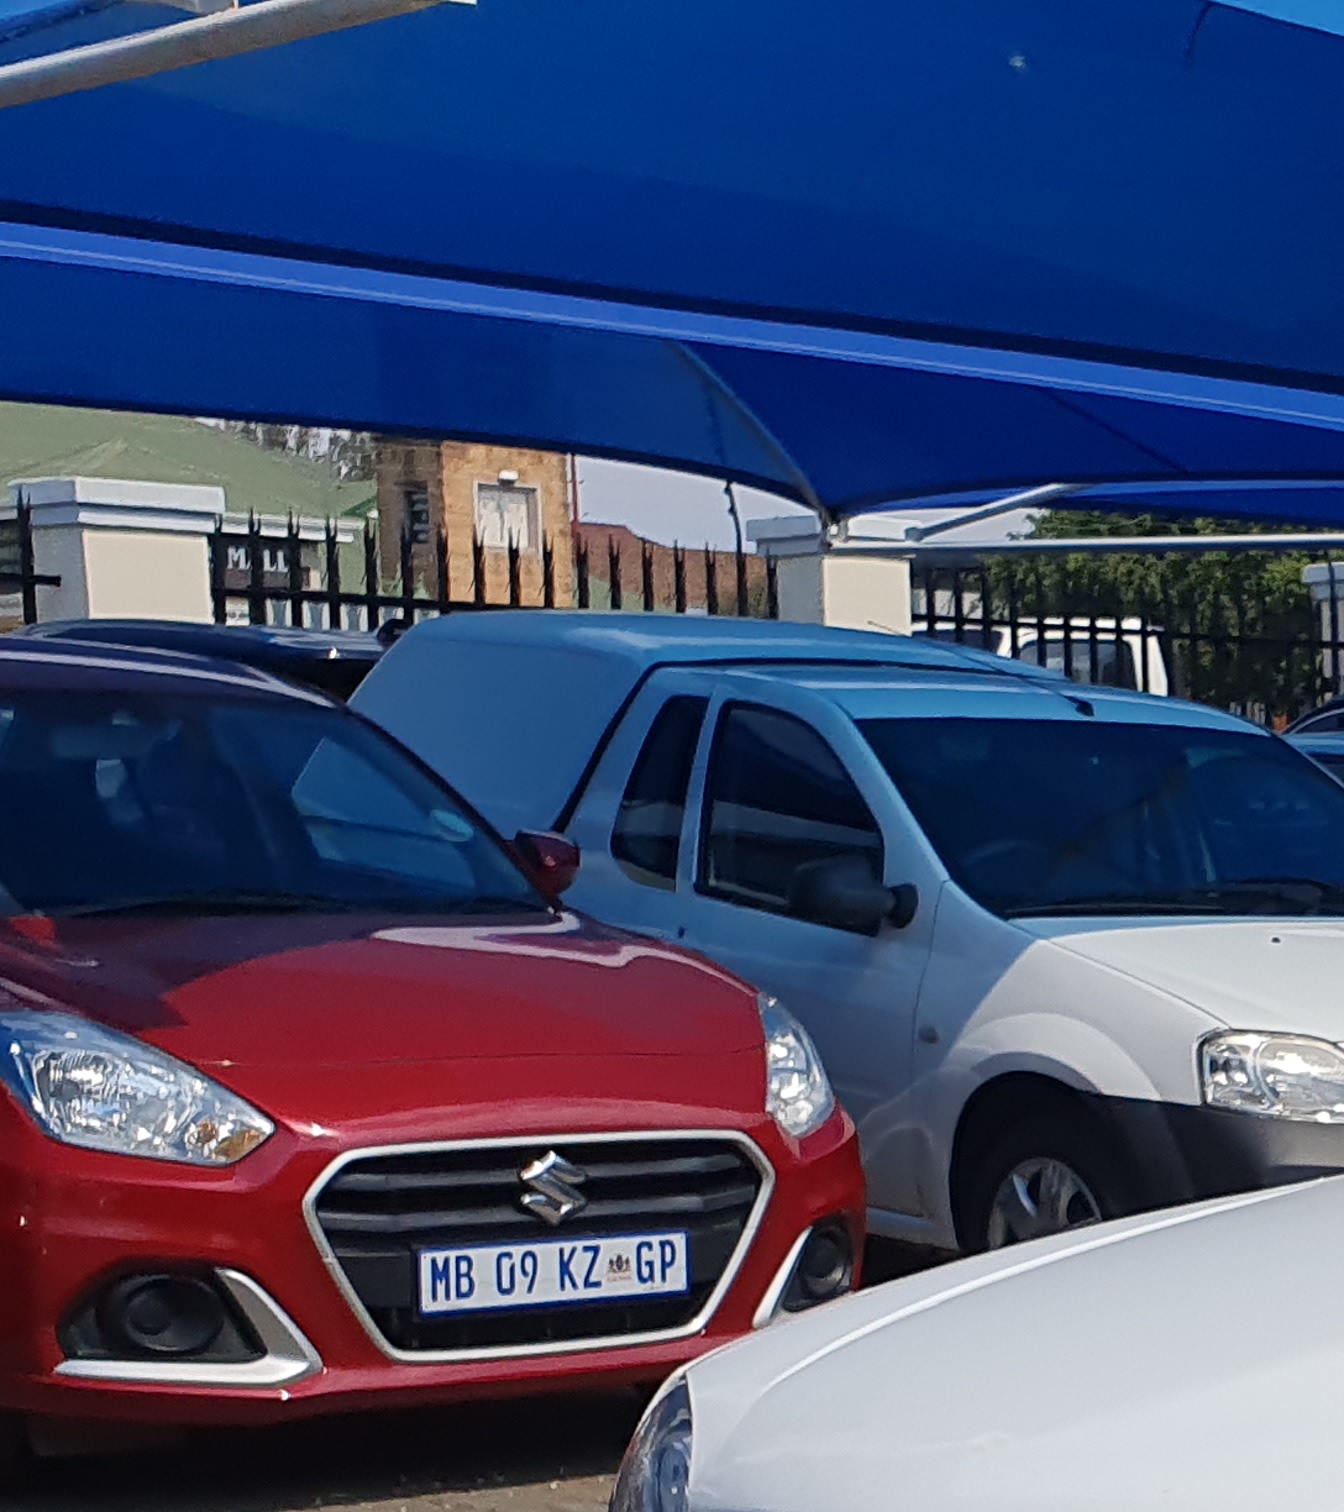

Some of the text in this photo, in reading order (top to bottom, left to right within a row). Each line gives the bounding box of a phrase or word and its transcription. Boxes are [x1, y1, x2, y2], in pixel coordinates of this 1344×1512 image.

[226, 545, 290, 573] MLL
[430, 1239, 677, 1302] MB 09 KZ GP
